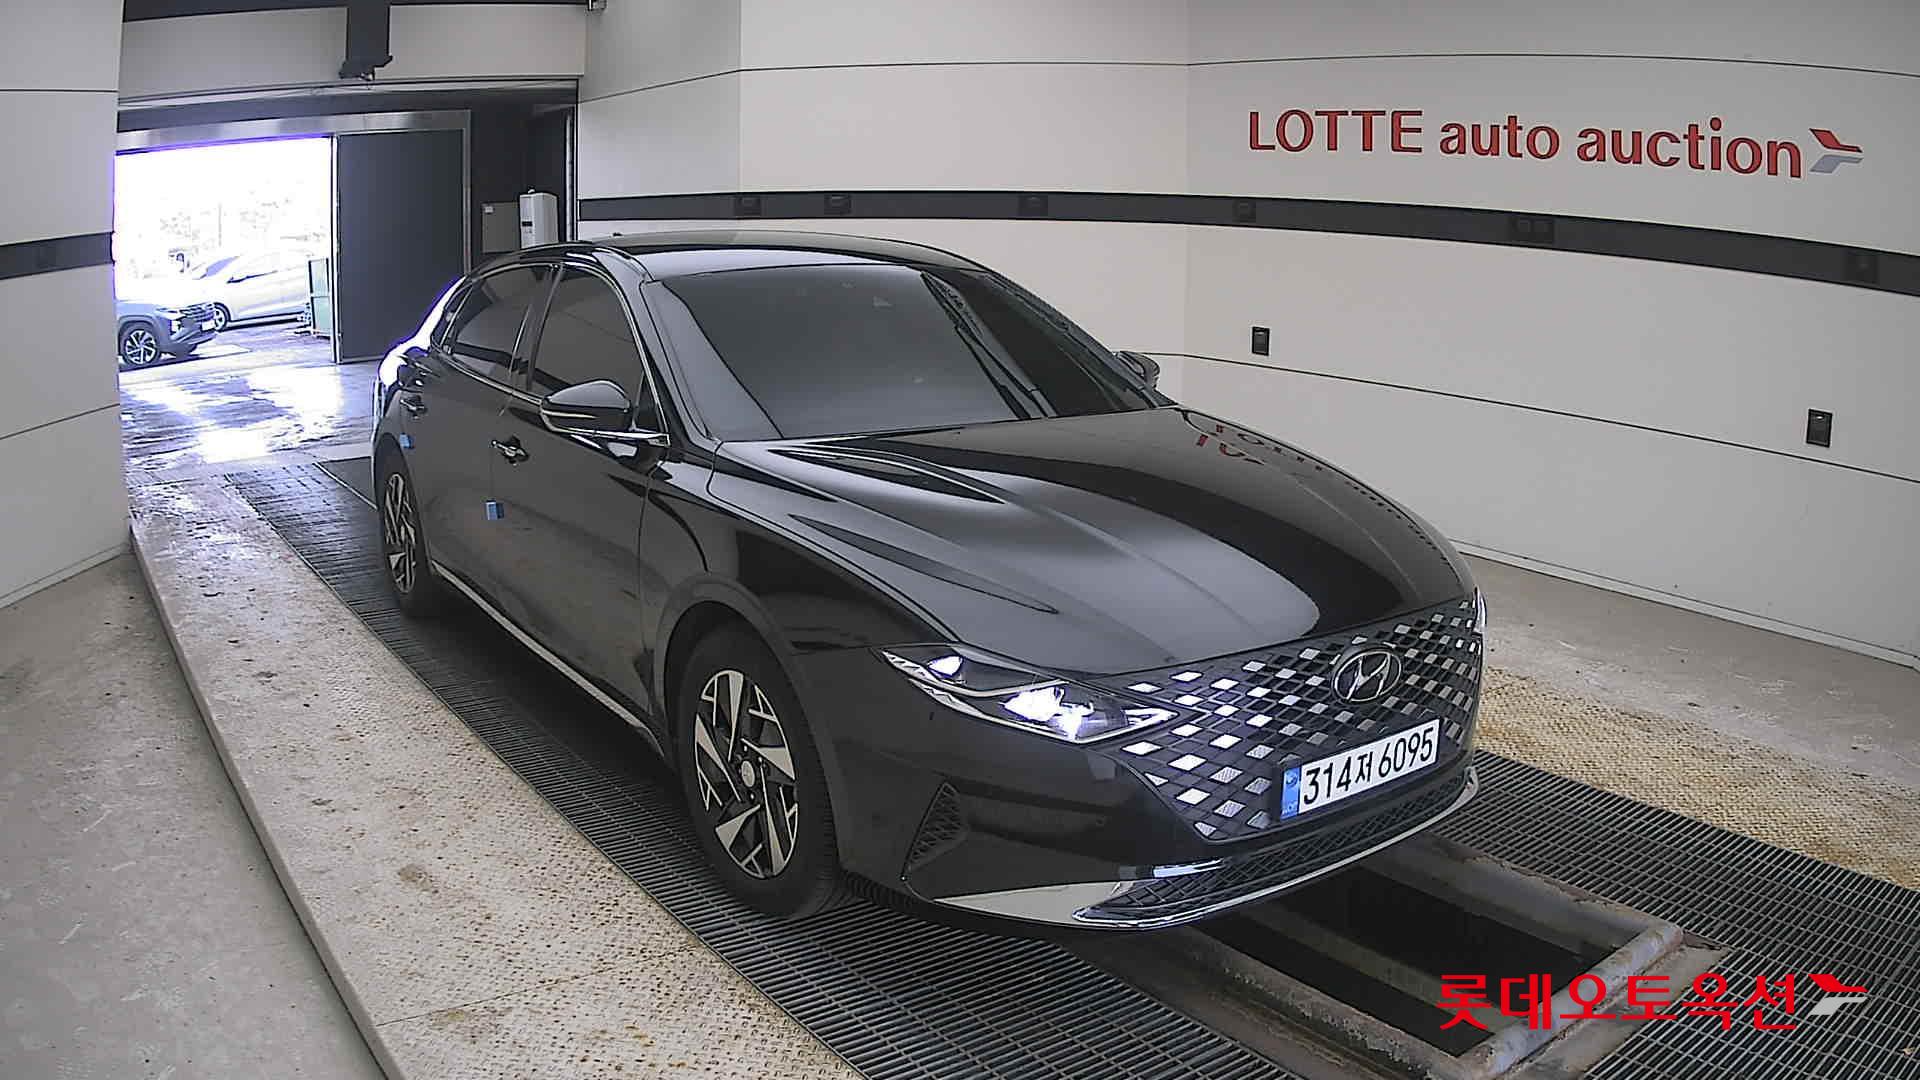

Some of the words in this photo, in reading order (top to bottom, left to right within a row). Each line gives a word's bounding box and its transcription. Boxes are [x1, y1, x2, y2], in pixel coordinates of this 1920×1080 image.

[1249, 110, 1423, 153] LOTTE
[1439, 115, 1560, 160] auto
[1576, 117, 1802, 178] auction
[1378, 727, 1434, 778] 6095
